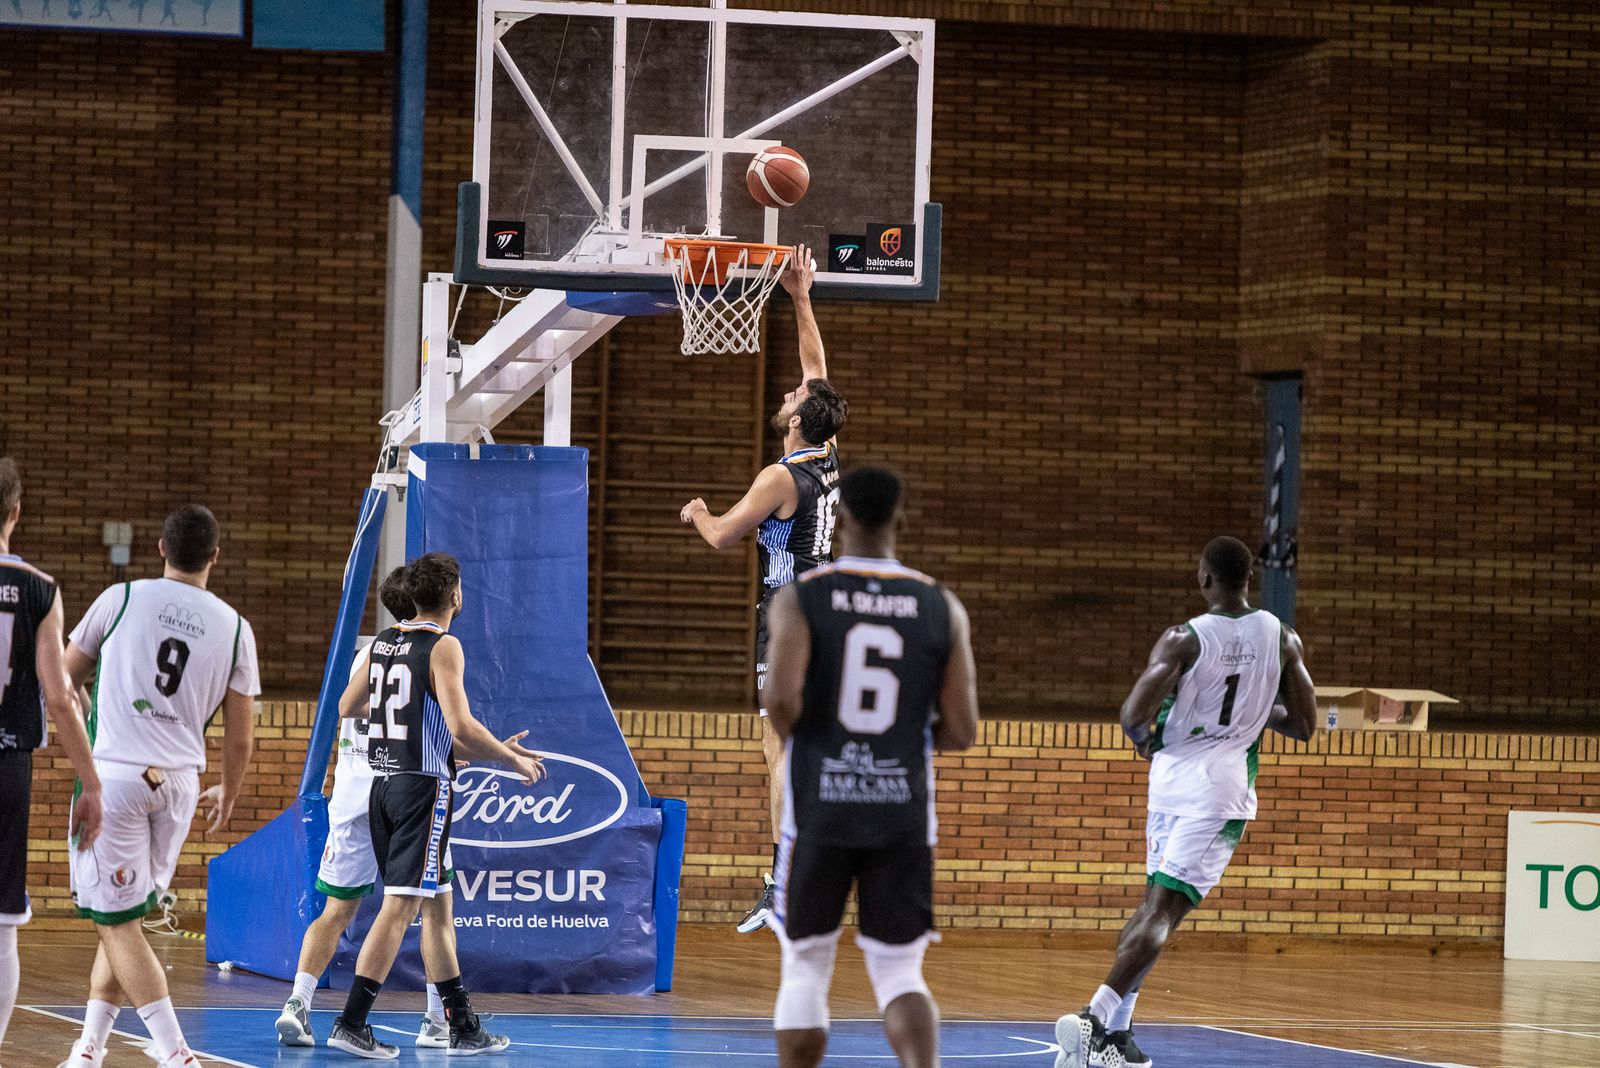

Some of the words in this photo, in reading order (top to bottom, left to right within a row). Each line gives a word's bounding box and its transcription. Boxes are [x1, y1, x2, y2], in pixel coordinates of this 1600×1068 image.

[866, 257, 914, 268] baloncesto
[155, 636, 190, 698] 9
[838, 622, 904, 735] 6
[368, 662, 412, 740] 22
[1218, 673, 1241, 726] 1
[450, 766, 576, 824] Ford
[424, 813, 447, 882] ENRIQUE
[456, 869, 606, 902] VESUR
[1525, 863, 1600, 911] TO
[454, 915, 483, 928] eva
[486, 914, 523, 928] Ford
[527, 914, 548, 928] de
[551, 914, 609, 928] Huelva
